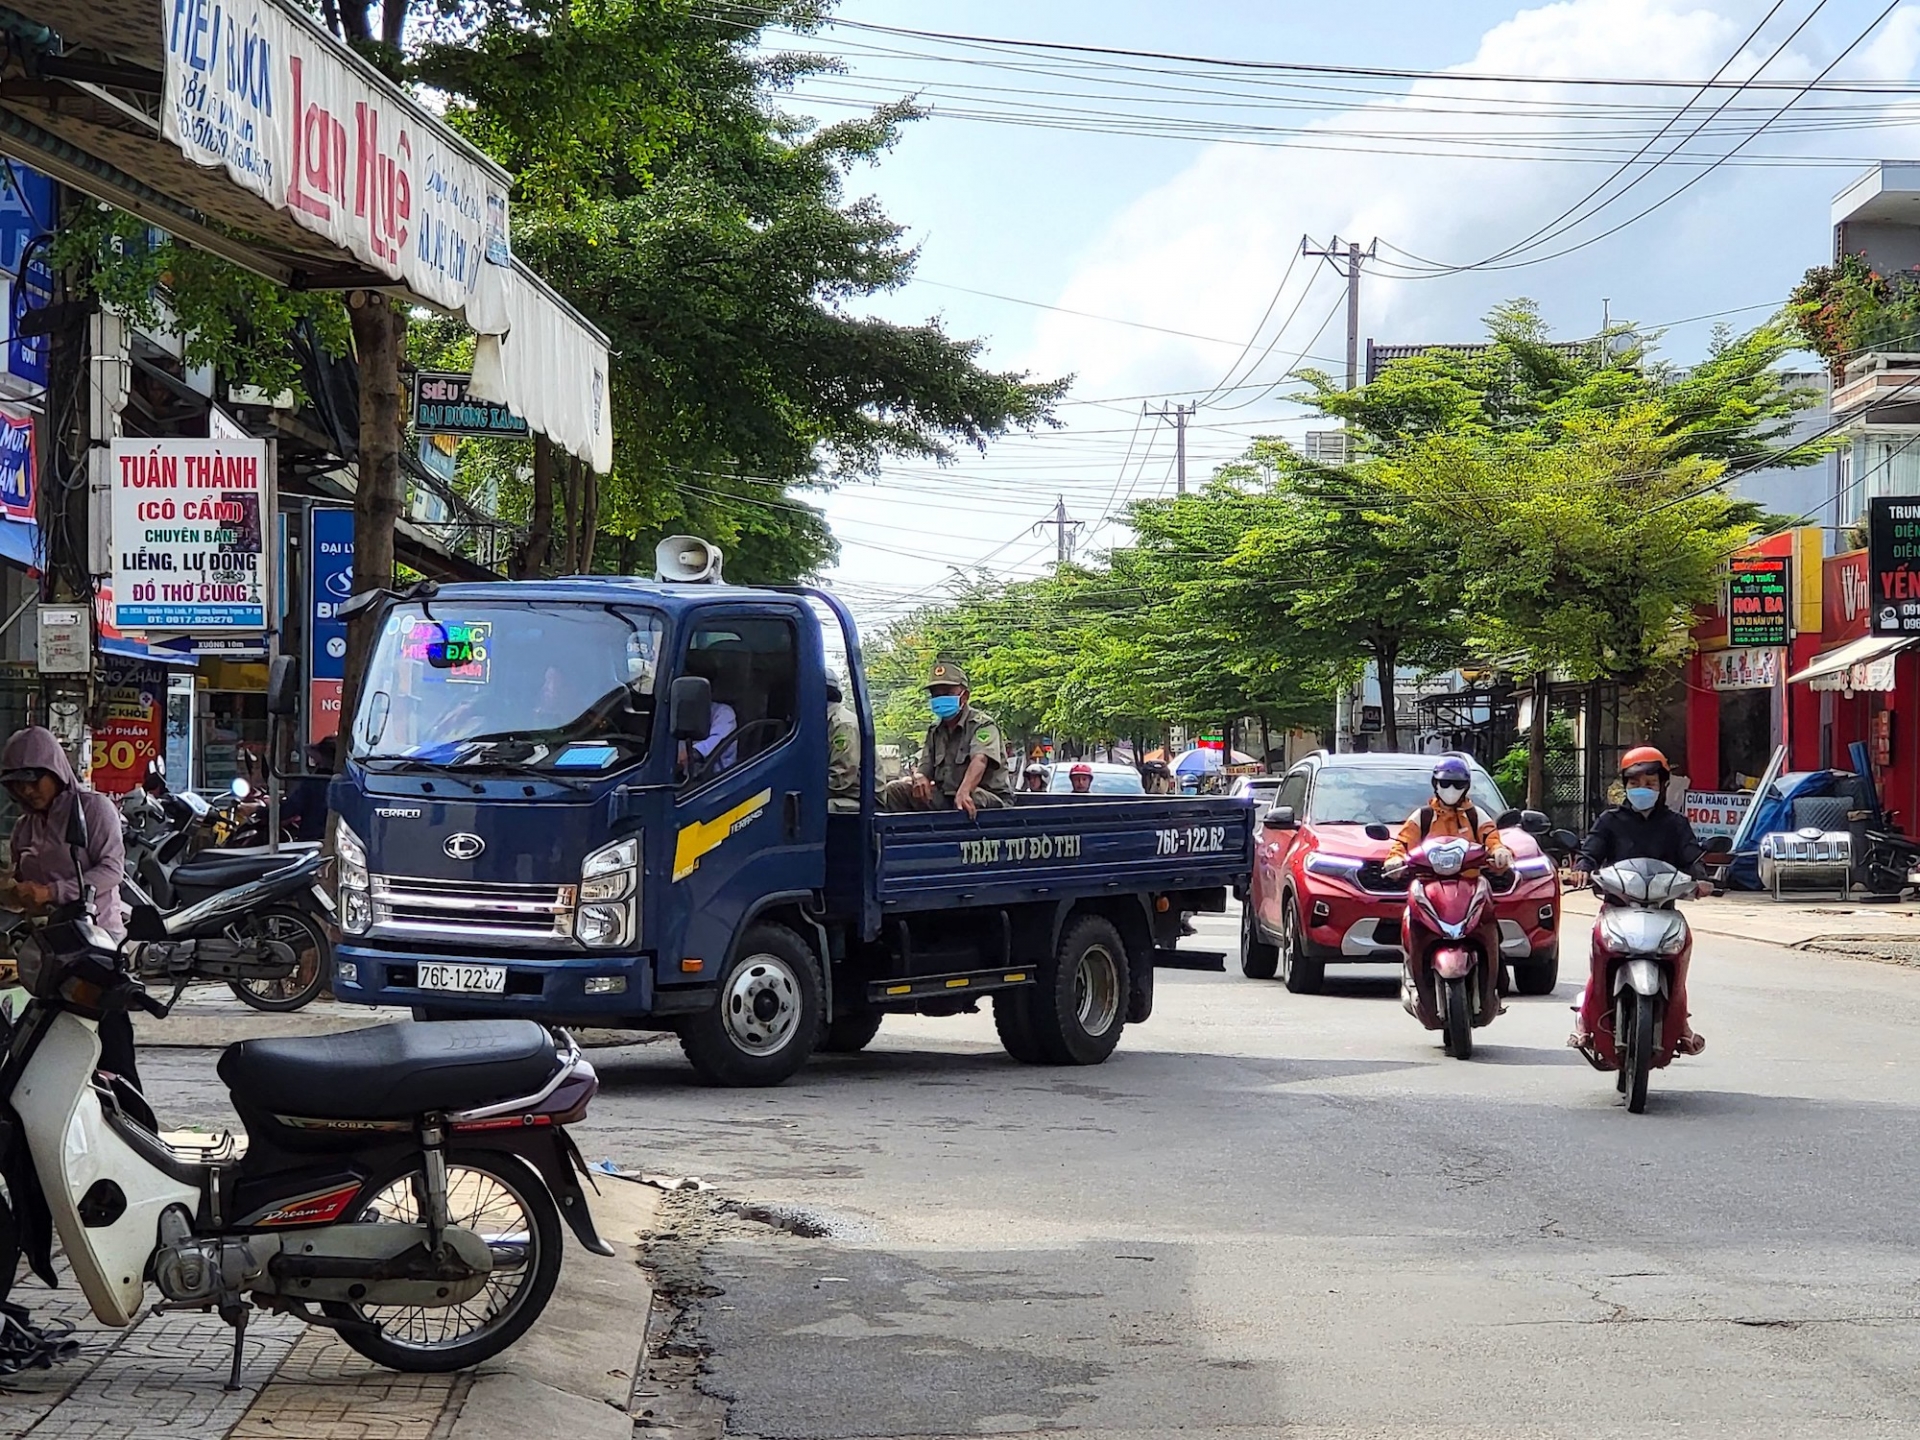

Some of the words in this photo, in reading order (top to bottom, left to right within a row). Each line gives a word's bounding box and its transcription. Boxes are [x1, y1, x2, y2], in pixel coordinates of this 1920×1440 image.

[287, 55, 347, 222] Lan
[421, 380, 459, 401] SIÊU
[119, 444, 177, 489] TUẤN
[184, 449, 258, 489] THÀNH
[138, 498, 176, 521] (CÔ
[144, 527, 200, 543] CHUYÊN
[204, 526, 237, 544] BÁN:
[183, 551, 206, 571] LƯ
[209, 545, 257, 571] ĐỒNG
[320, 542, 342, 556] ĐẠI
[132, 578, 156, 602] ĐỒ
[161, 580, 196, 602] THỜ
[200, 579, 248, 602] CÚNG
[1733, 597, 1762, 613] HOA
[1764, 596, 1784, 613] BA
[1705, 793, 1728, 806] HÀNG
[374, 807, 421, 819] TERACO
[1687, 808, 1721, 825] HOA
[1156, 826, 1225, 855] 76C-122.62
[960, 836, 1001, 867] TRẬT
[1054, 834, 1081, 861] THỊ
[327, 1121, 375, 1130] KOREA
[262, 1210, 320, 1221] Dream
